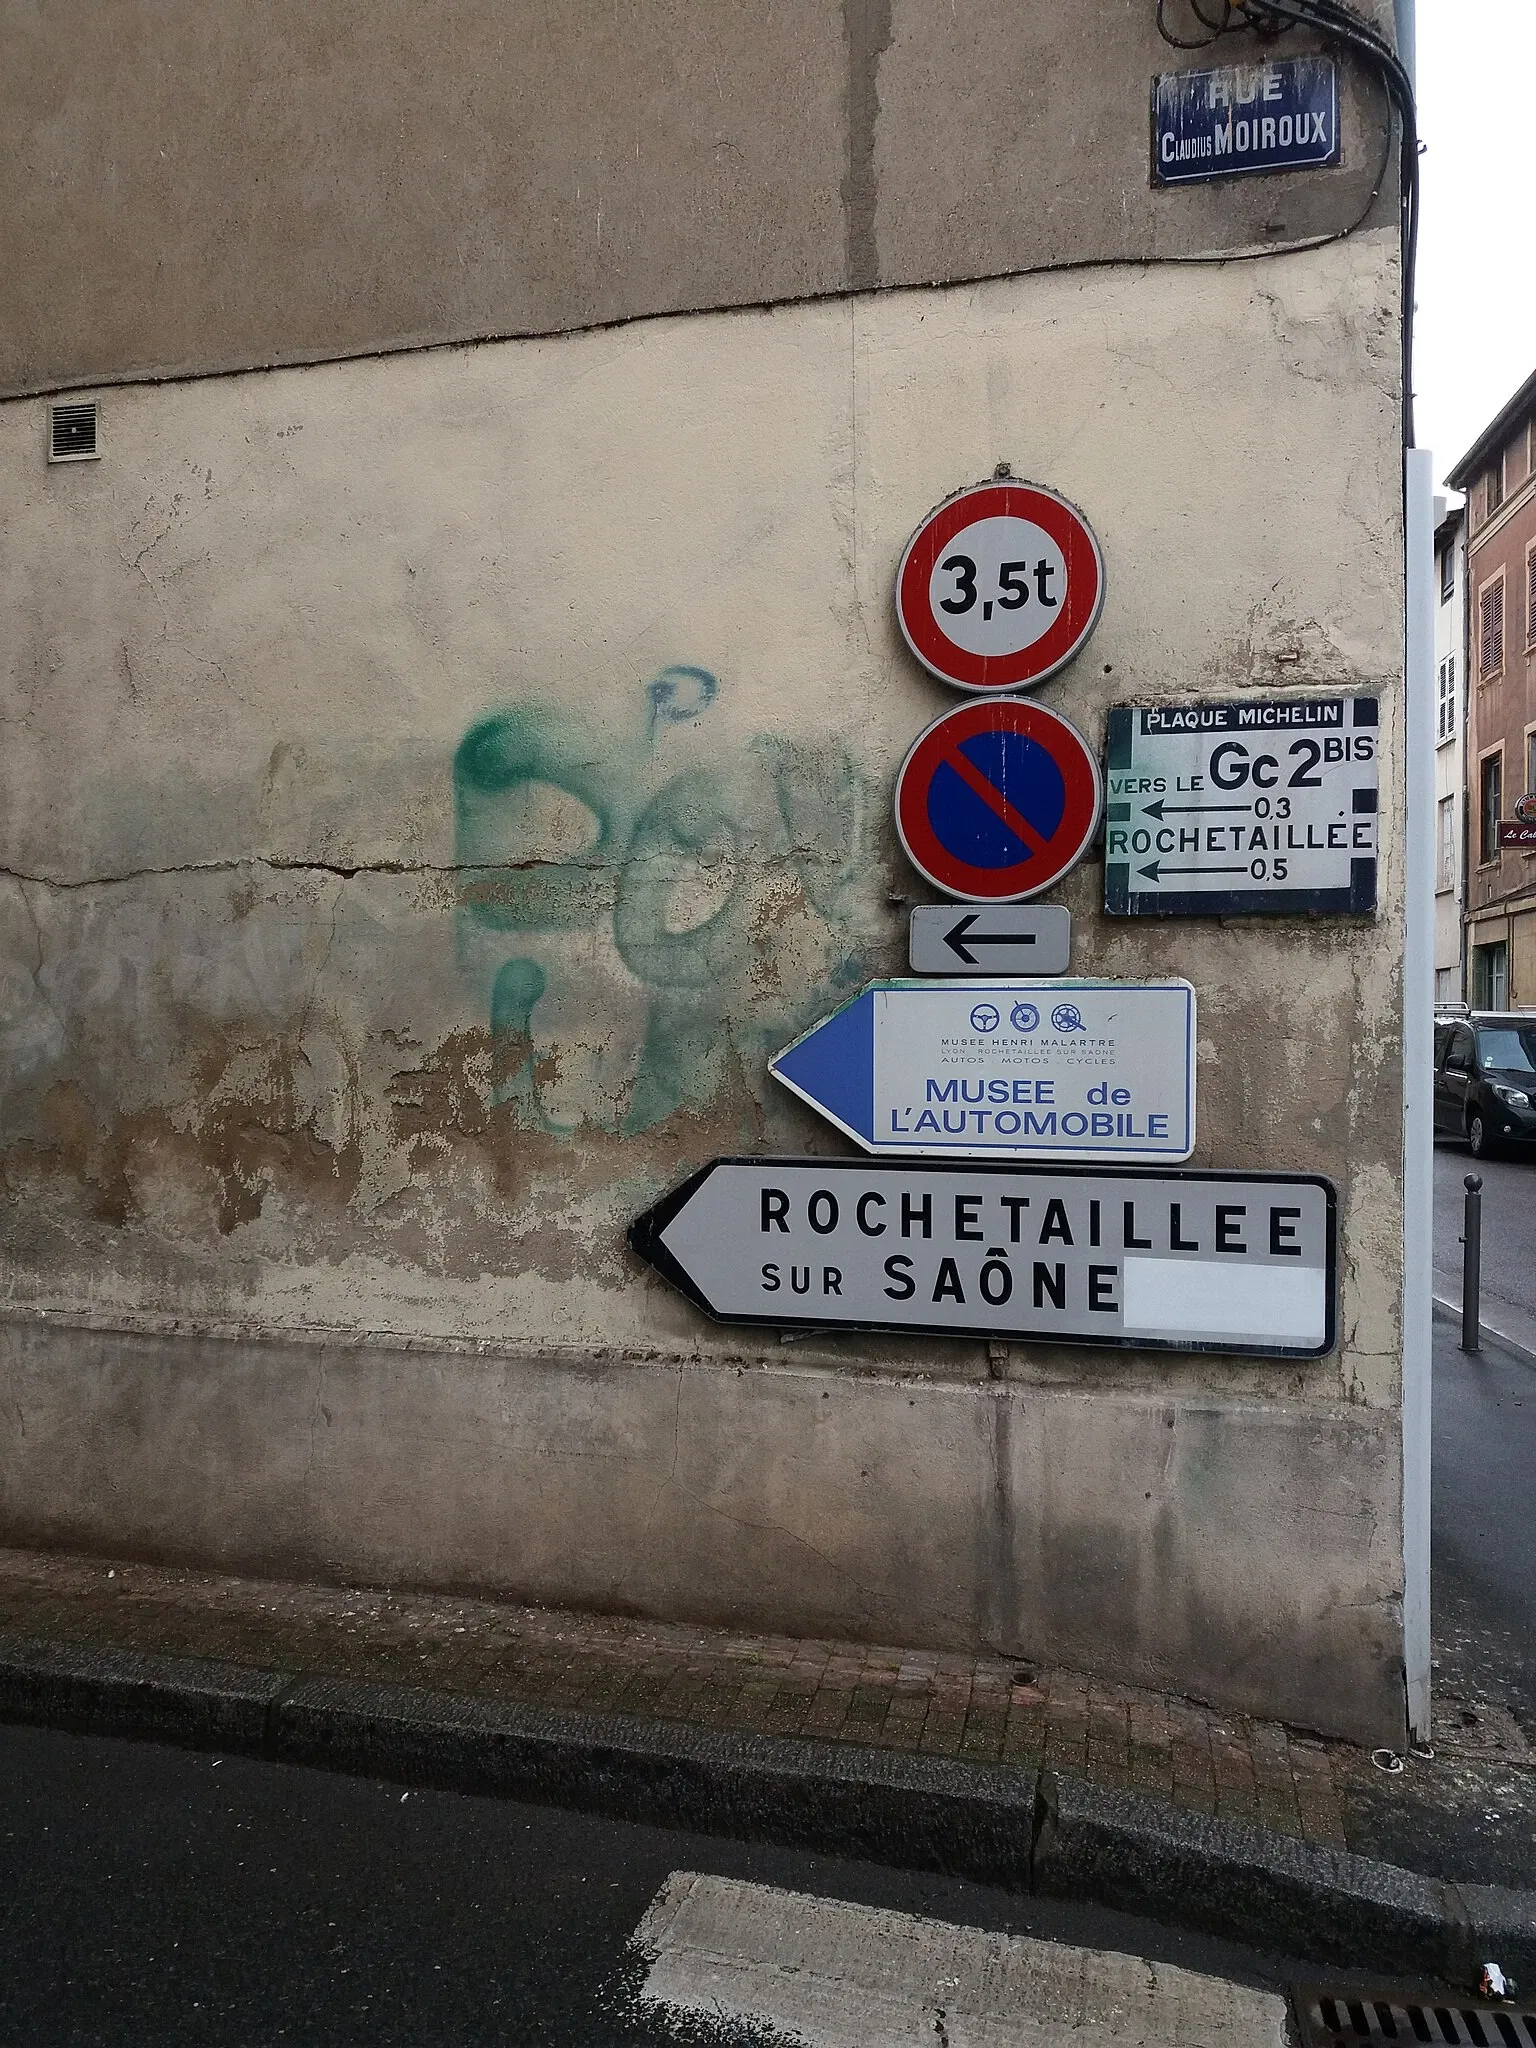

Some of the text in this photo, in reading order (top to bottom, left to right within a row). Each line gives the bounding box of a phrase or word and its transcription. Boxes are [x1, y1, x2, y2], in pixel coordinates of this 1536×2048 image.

[1209, 73, 1283, 110] RUE
[1214, 111, 1327, 156] MOIROUX
[939, 554, 1058, 621] 3,5t
[1147, 705, 1338, 729] PLAQUE MICHELIN
[1110, 778, 1167, 794] VERS
[1176, 775, 1204, 792] LE
[1254, 797, 1292, 820] 0,3
[1503, 829, 1517, 839] Le
[1250, 858, 1288, 881] 0,5
[941, 1038, 985, 1046] MUSEE
[1040, 1039, 1116, 1047] MALARTRE
[926, 1079, 1131, 1105] MUSEE de
[891, 1107, 1169, 1139] L'AUTOMOBILE
[760, 1187, 1302, 1257] ROCHETAILLEE
[760, 1246, 1120, 1313] SUR SAÔNE
